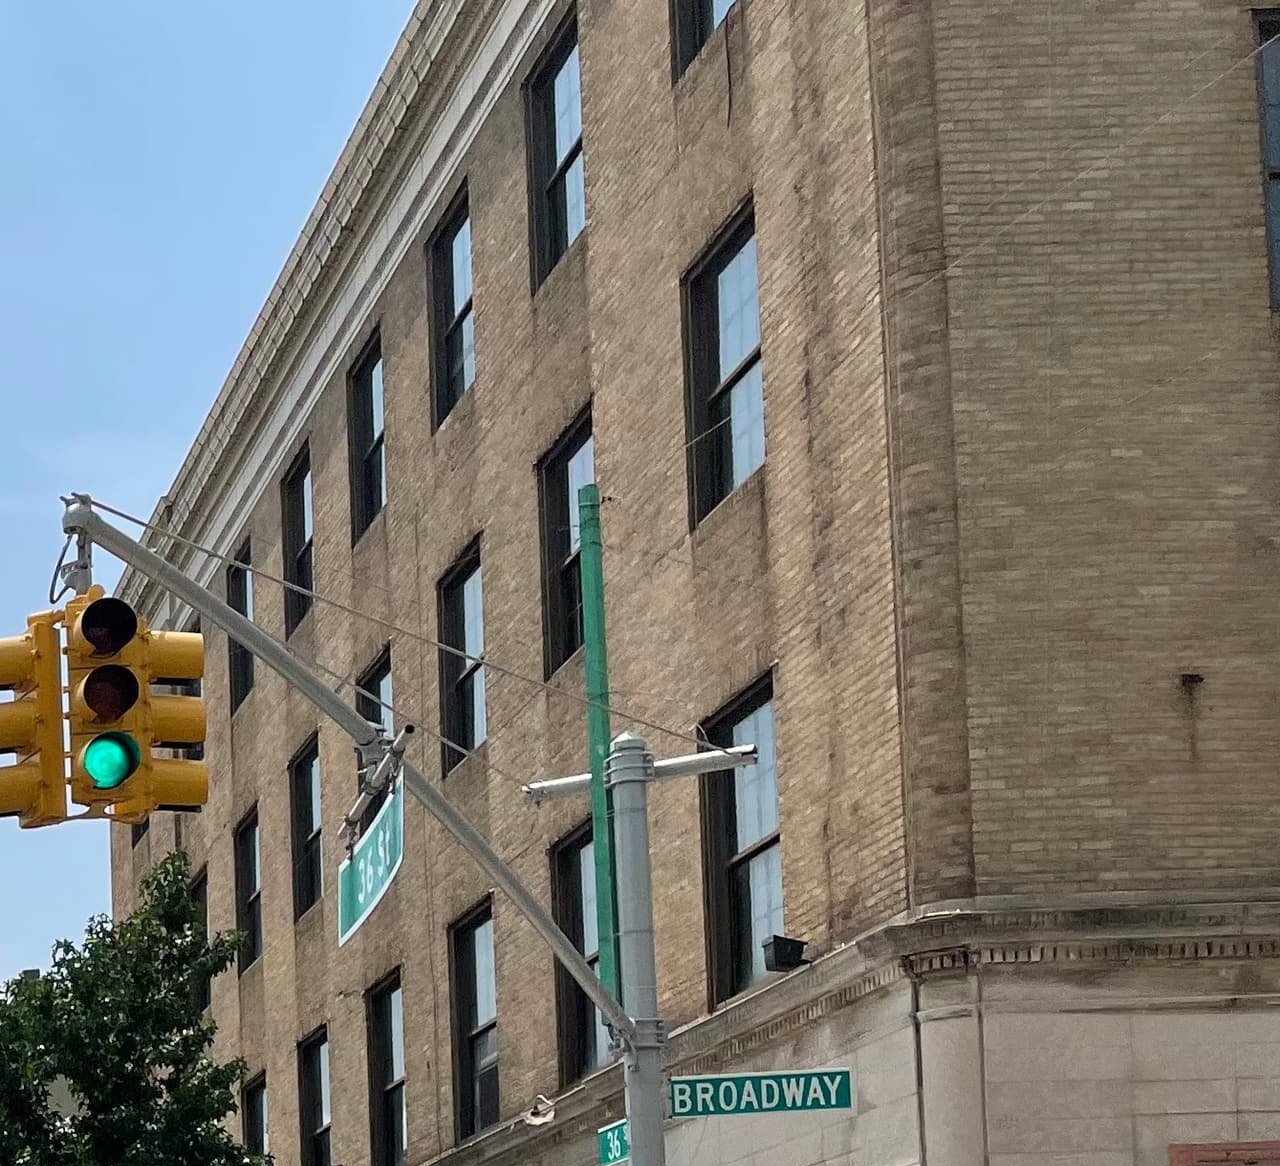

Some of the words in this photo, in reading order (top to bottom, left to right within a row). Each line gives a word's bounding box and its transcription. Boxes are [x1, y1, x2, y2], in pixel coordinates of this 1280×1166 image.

[357, 847, 374, 904] 36
[673, 1075, 842, 1113] BROADWAY
[607, 1129, 621, 1160] 36
